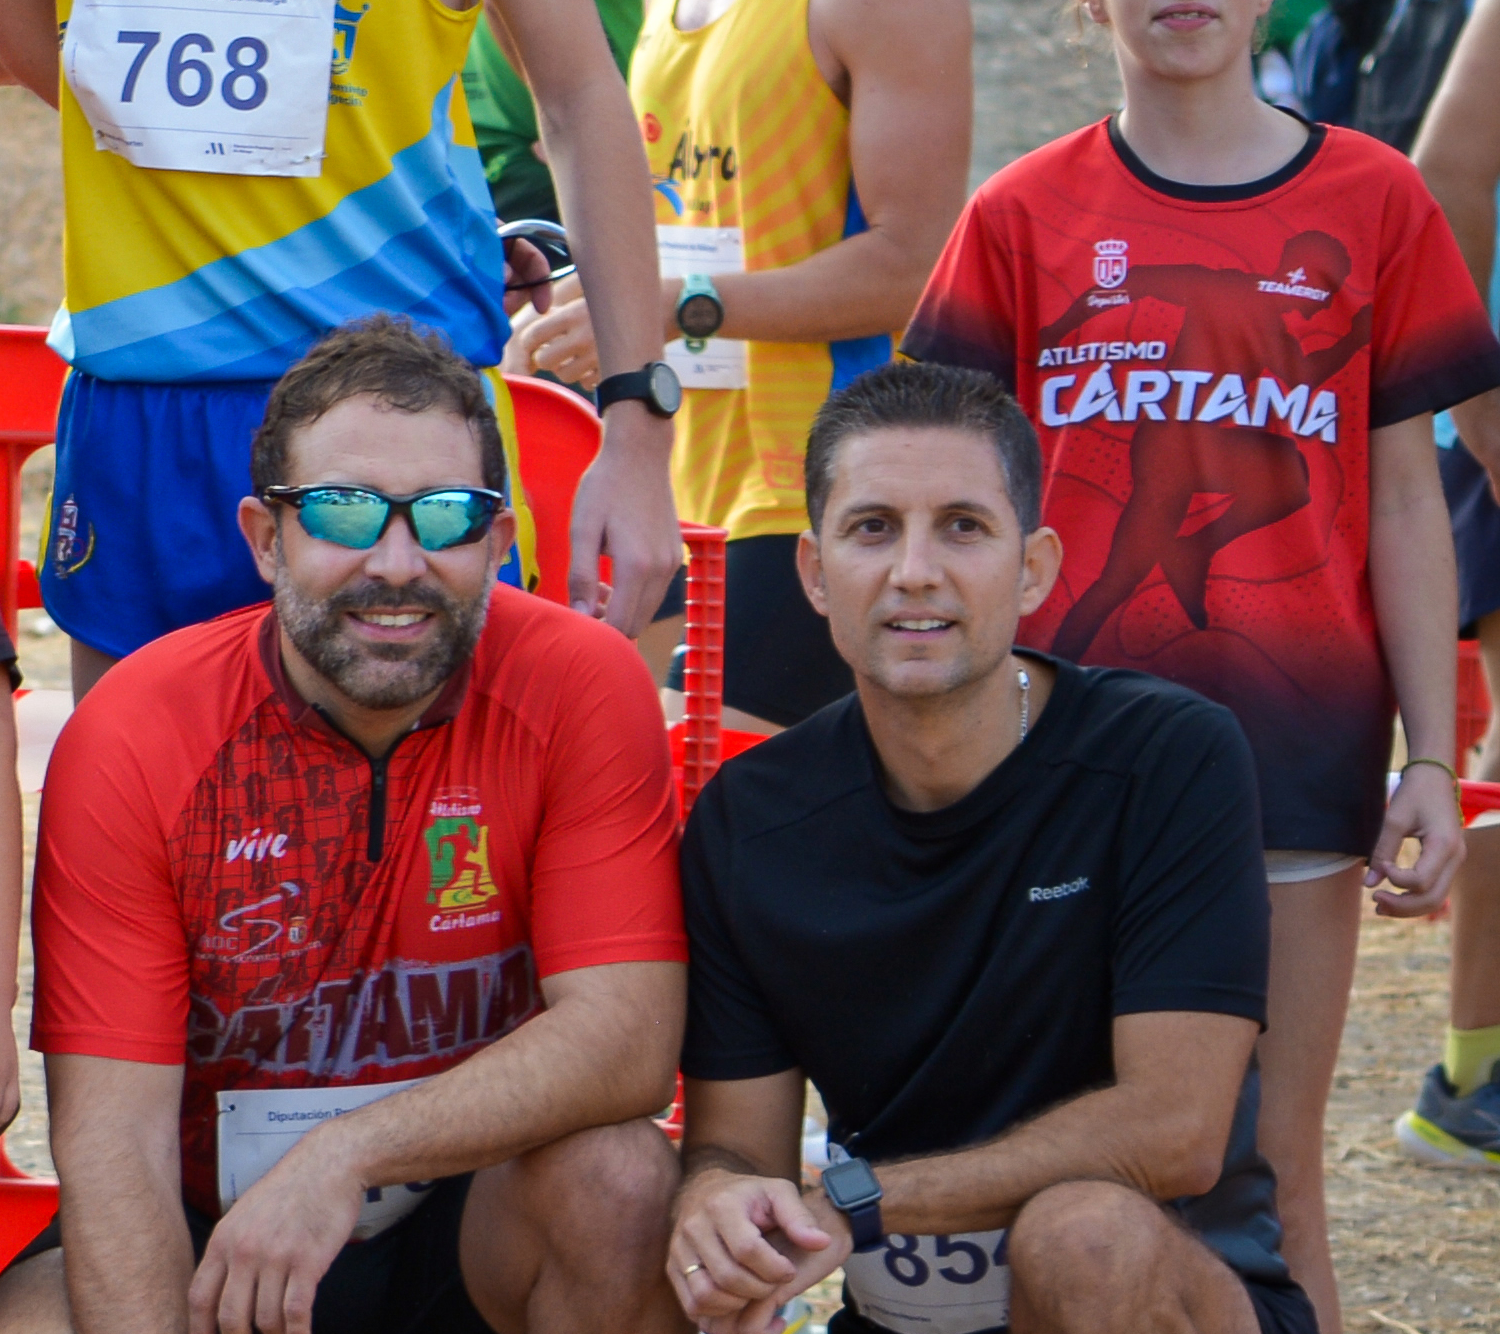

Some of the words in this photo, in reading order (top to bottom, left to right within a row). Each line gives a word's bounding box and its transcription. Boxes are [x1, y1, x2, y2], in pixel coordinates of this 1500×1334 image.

[116, 30, 270, 112] 768
[1257, 279, 1330, 302] TEAMERGY
[1038, 340, 1167, 367] ATLETISMO
[1040, 361, 1339, 444] CÁRTAMA
[225, 827, 289, 864] vive
[1028, 876, 1092, 903] Reebok
[430, 910, 502, 933] Cártama
[267, 1108, 333, 1124] Diputación
[883, 1231, 1011, 1288] 85
